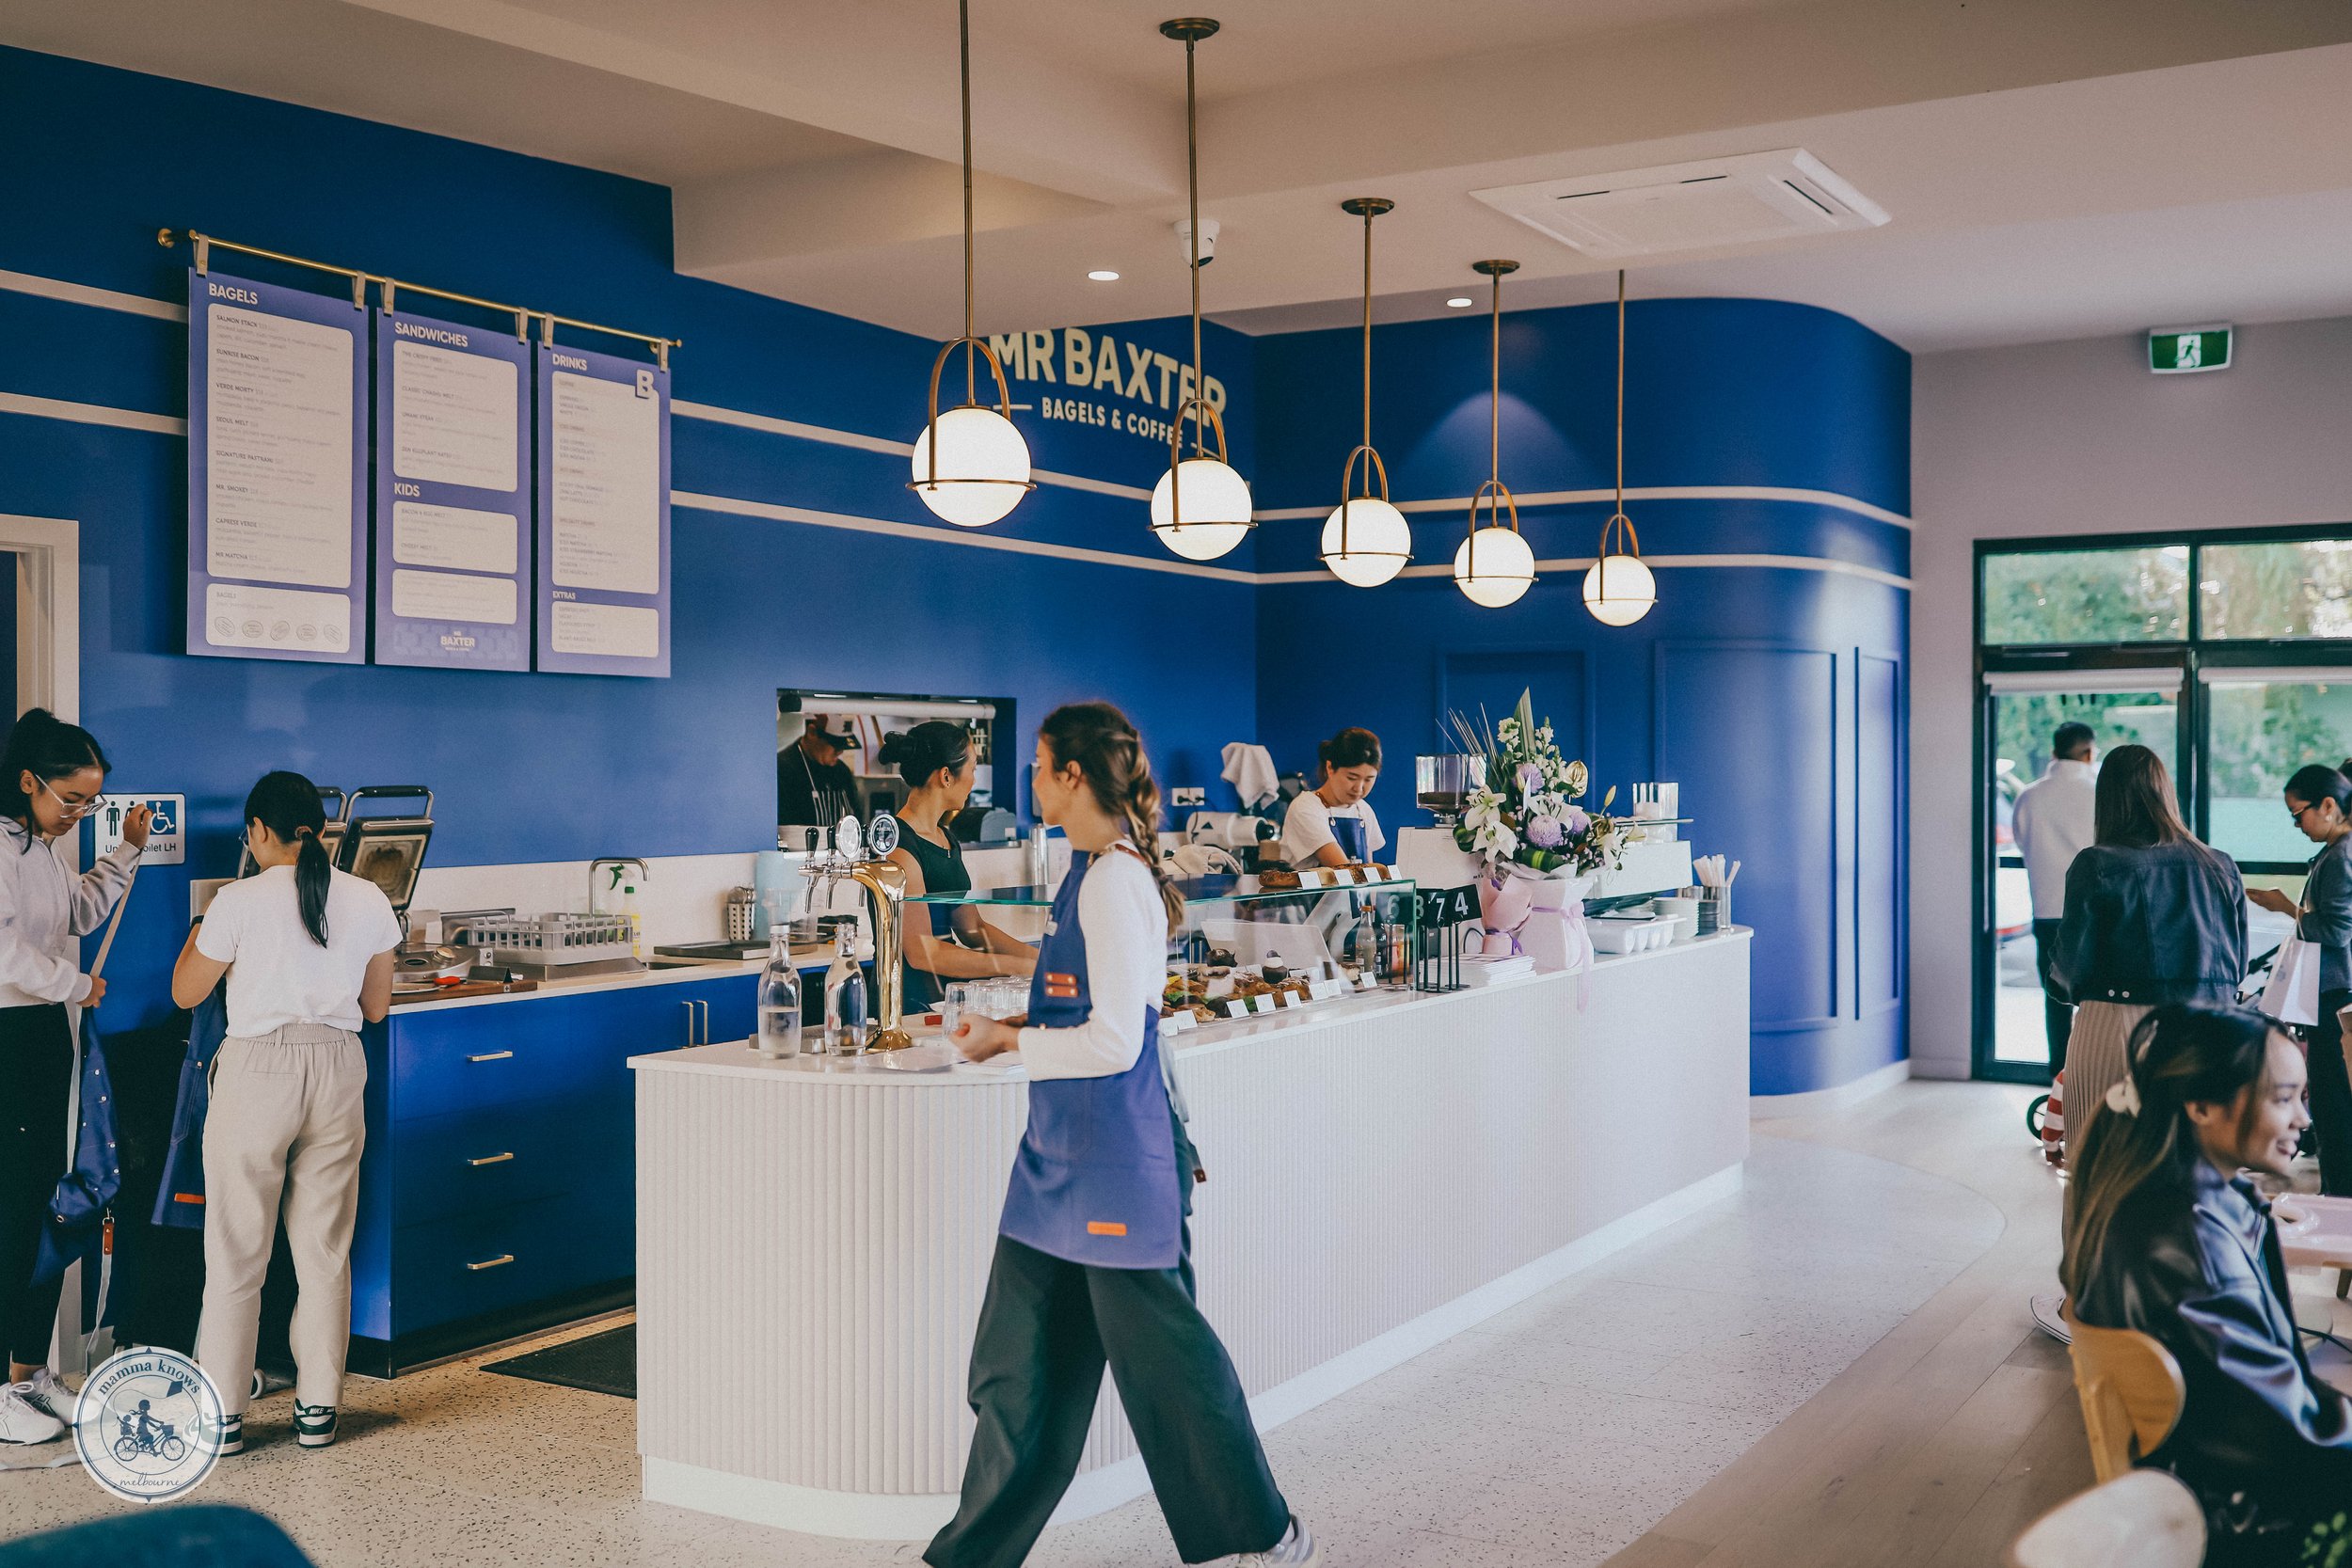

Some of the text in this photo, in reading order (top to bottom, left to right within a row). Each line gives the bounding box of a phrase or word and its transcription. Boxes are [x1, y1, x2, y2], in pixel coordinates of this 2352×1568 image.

[209, 282, 258, 305] BAGELS
[216, 314, 257, 328] SALMON STACK
[395, 321, 468, 347] SANDWICHES
[216, 348, 260, 361] SUNRISE BACON
[552, 353, 587, 371] DRINKS
[636, 369, 654, 398] B
[989, 326, 1227, 428] MR BAXTER
[216, 382, 254, 393] VERDE MORTY
[1042, 396, 1106, 427] BAGELS
[1111, 412, 1122, 429] &
[216, 416, 234, 424] SEOUL
[216, 450, 246, 460] SIGNATURE
[227, 485, 249, 494] SMOKEY
[394, 482, 421, 497] KIDS
[215, 518, 239, 527] CAPRESE
[225, 552, 248, 561] MATCHA
[552, 590, 576, 600] EXTRAS
[440, 636, 475, 648] BAXTER
[143, 843, 176, 852] oilet LH
[1387, 895, 1400, 919] 6
[1436, 898, 1445, 921] 7
[1455, 892, 1468, 915] 4
